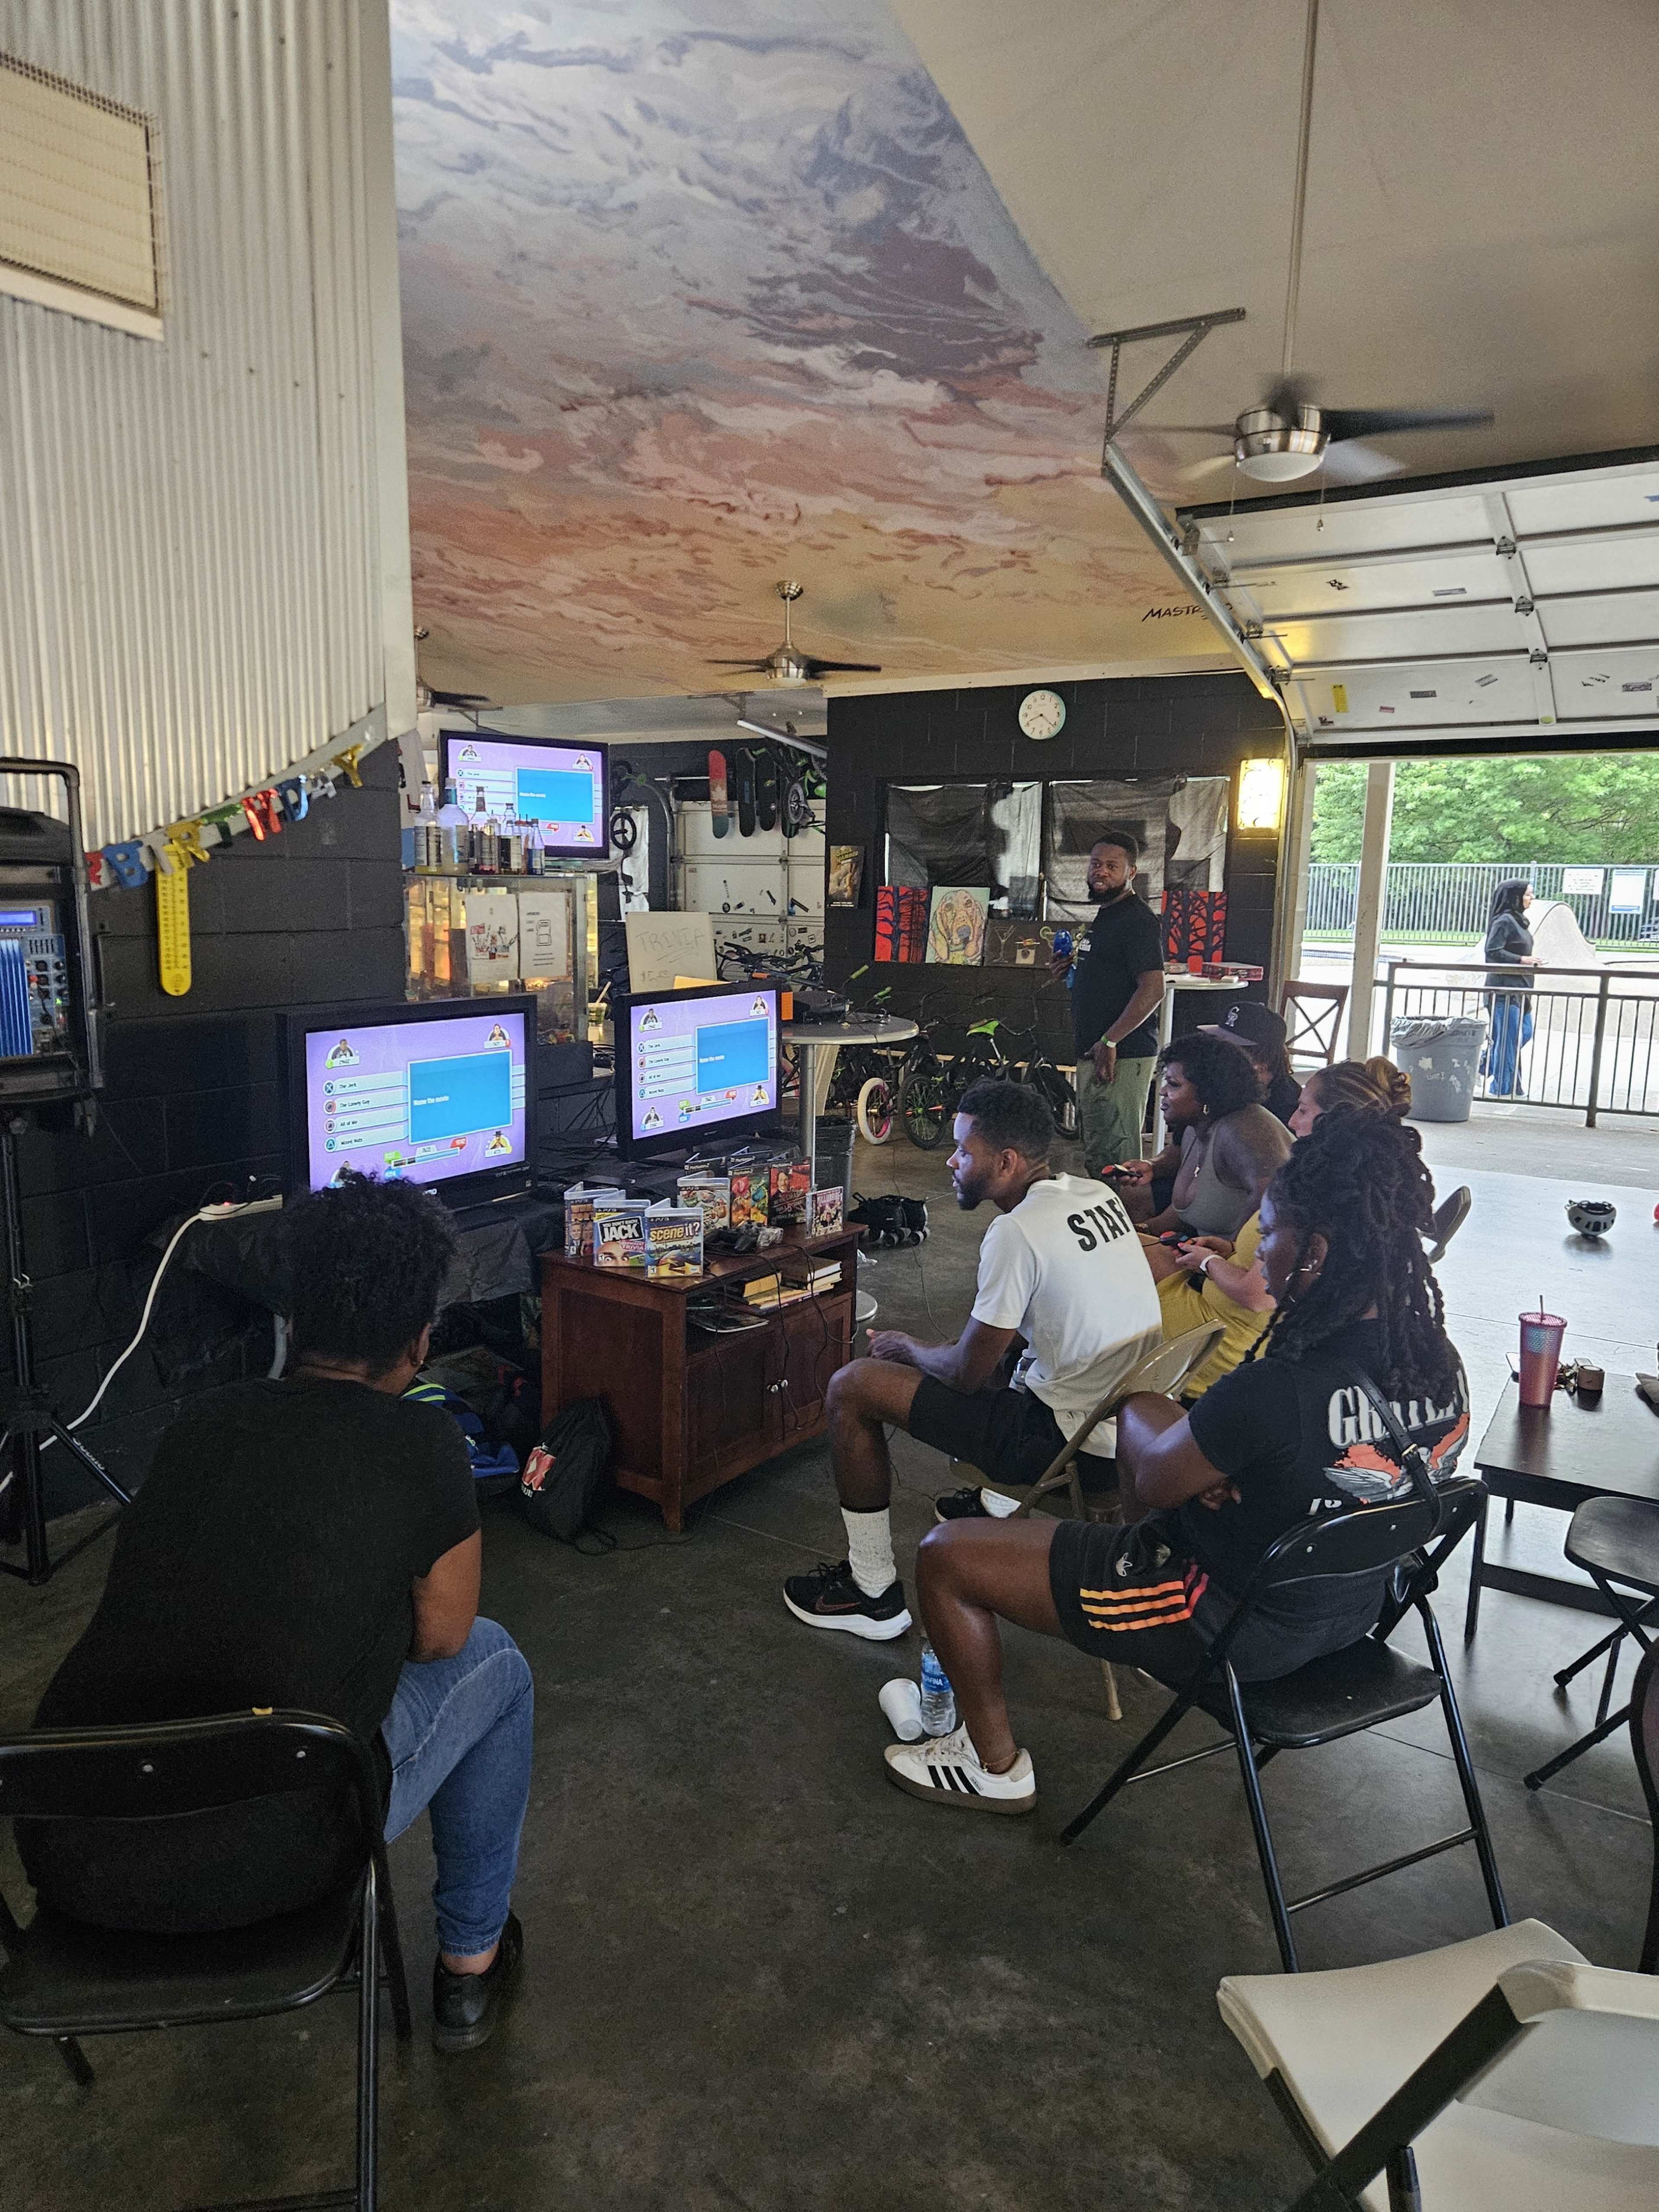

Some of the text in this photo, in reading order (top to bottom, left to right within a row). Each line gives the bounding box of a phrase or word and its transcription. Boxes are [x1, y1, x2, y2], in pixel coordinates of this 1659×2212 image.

[603, 1224, 639, 1242] JACK
[649, 1222, 700, 1242] scene it?
[1067, 1197, 1131, 1252] STAF
